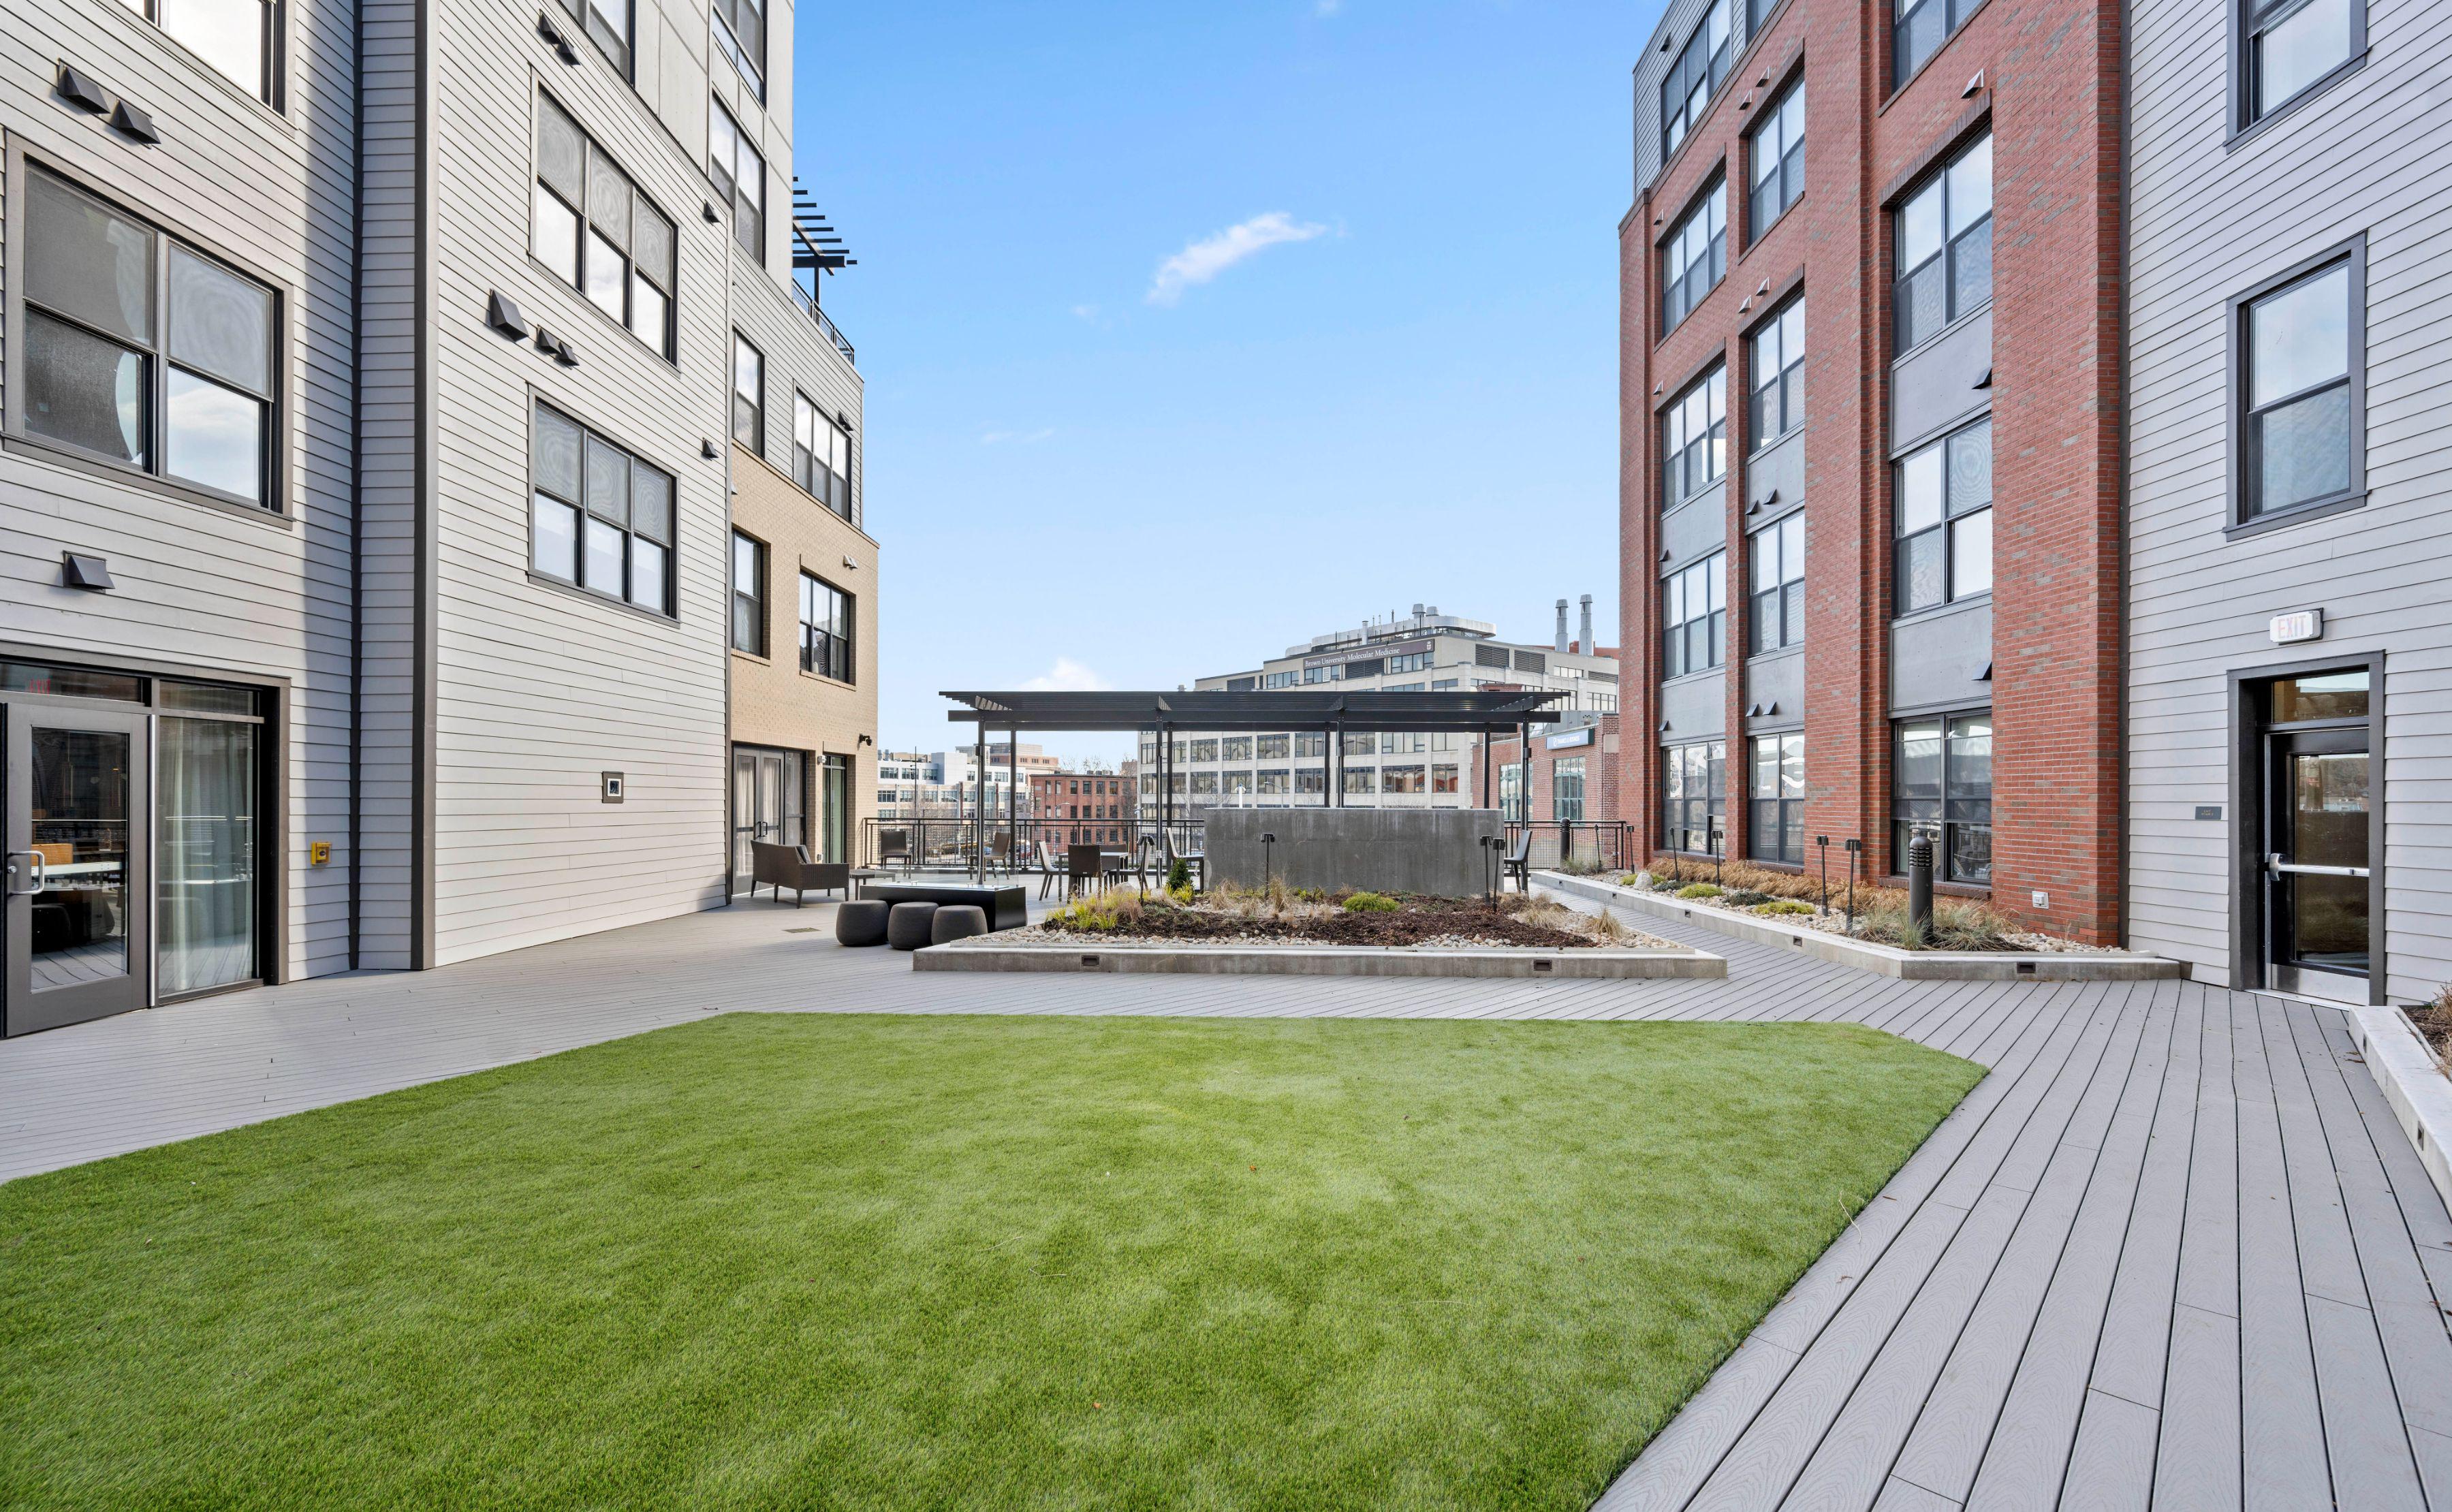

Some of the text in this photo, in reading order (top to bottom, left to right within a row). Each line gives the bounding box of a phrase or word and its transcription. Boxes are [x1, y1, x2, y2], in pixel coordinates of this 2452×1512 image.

[2278, 615, 2306, 639] EXIT
[1321, 655, 1346, 665] University
[1347, 652, 1374, 661] Molecular
[1375, 648, 1400, 657] Medicine
